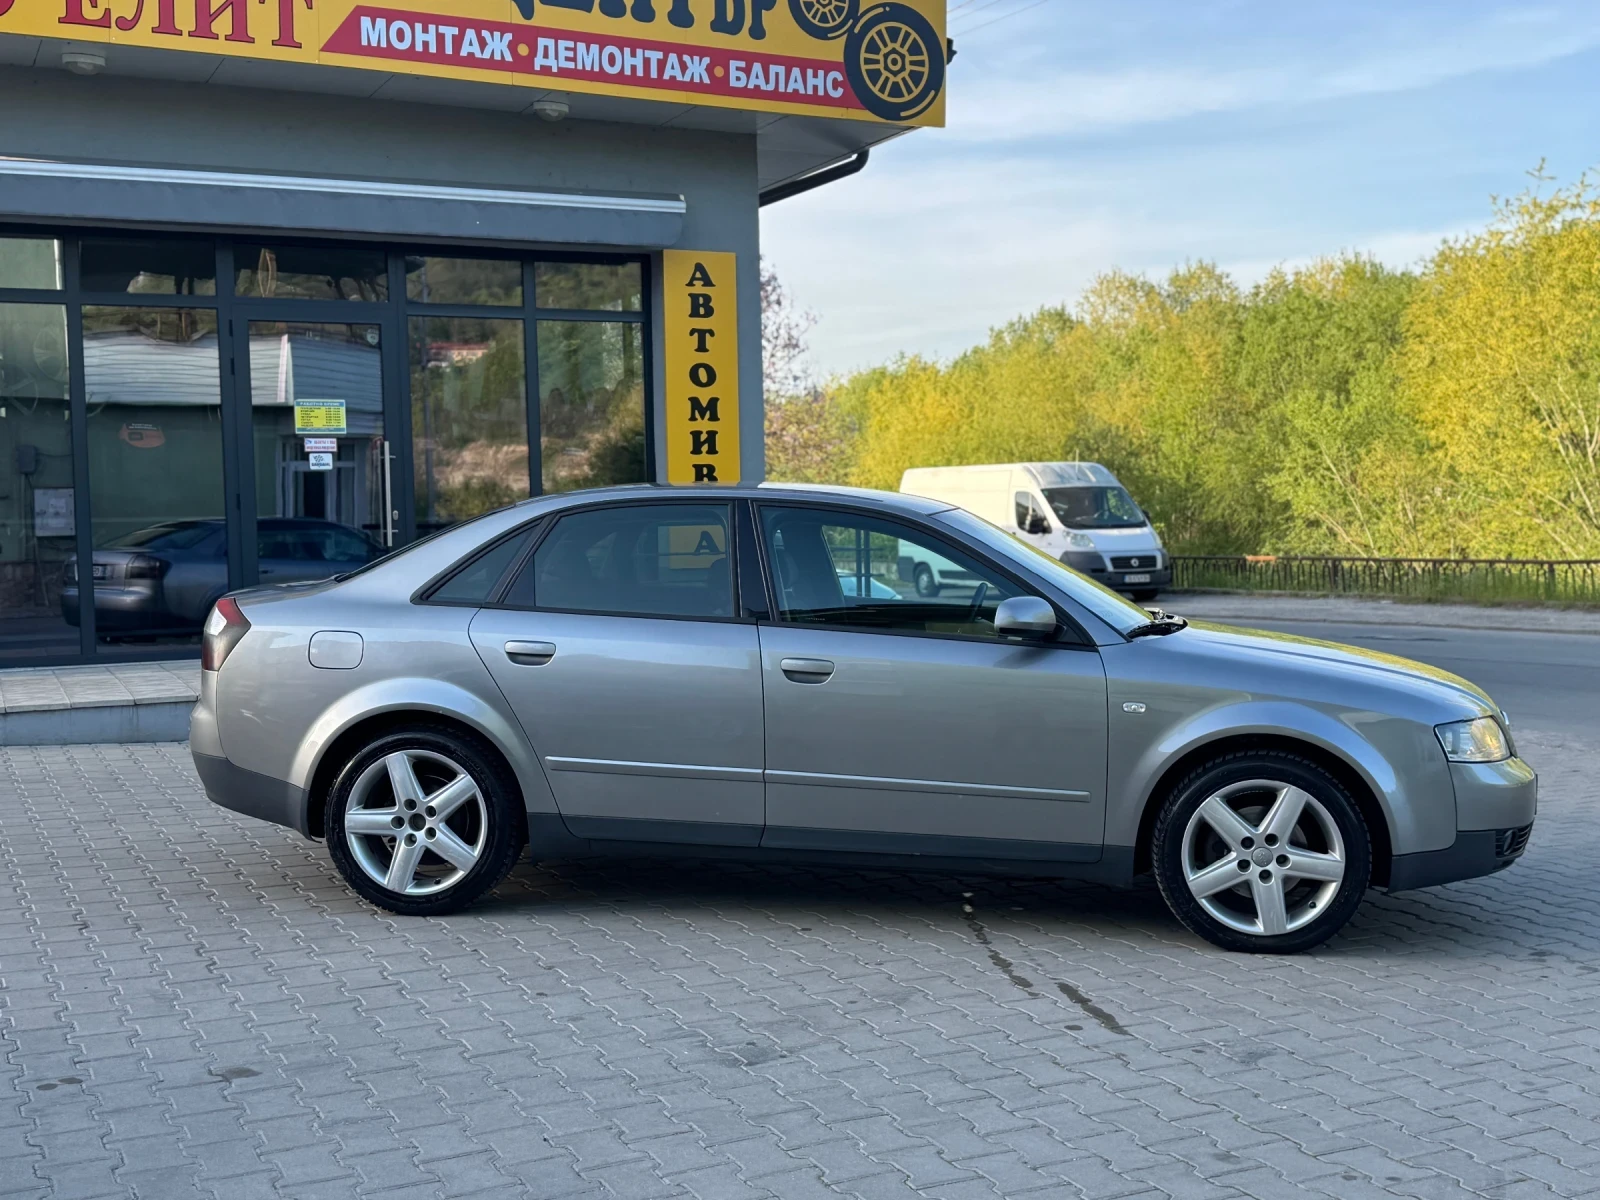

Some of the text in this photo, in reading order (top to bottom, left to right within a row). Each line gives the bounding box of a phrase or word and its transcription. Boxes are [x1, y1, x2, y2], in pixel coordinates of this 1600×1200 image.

[360, 15, 513, 63] МОНТАЖ
[534, 37, 710, 84] ДЕМОНТАЖ
[728, 60, 845, 98] БАЛАНС
